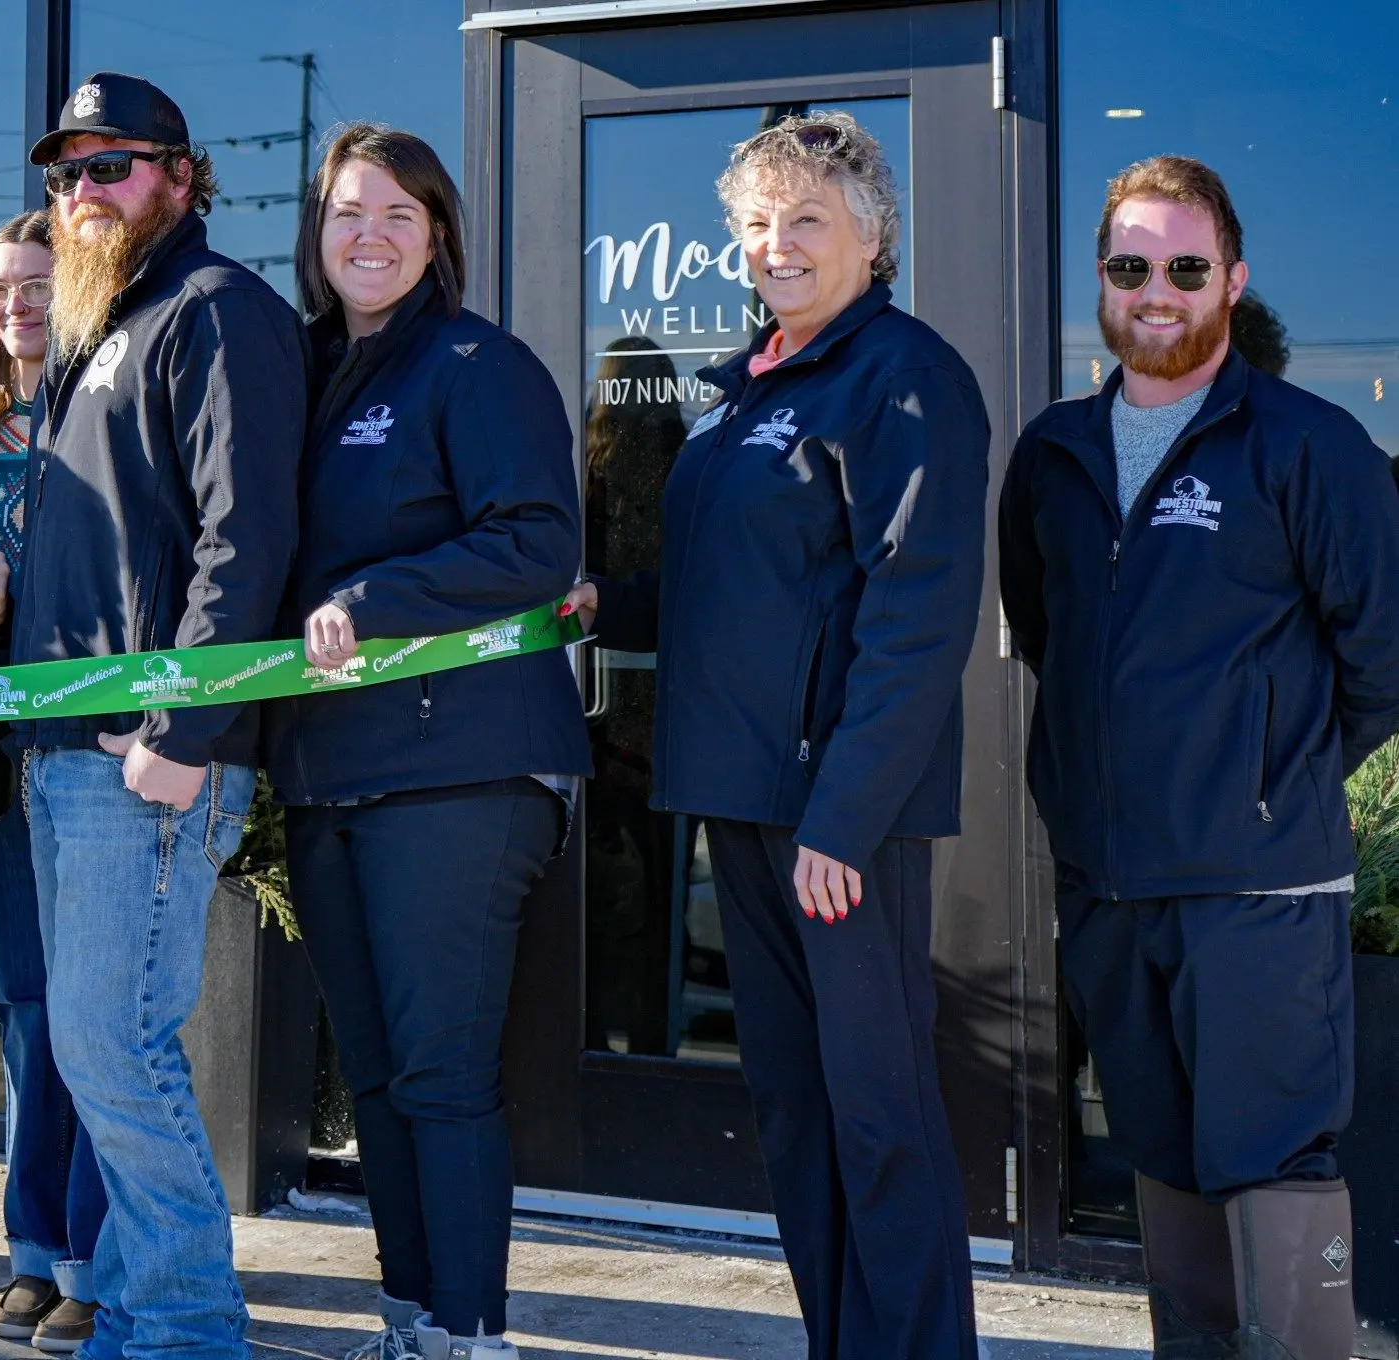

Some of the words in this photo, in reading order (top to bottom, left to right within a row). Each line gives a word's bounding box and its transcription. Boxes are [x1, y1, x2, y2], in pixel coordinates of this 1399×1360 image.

[598, 378, 631, 406] 1107
[637, 377, 651, 404] N
[655, 377, 716, 404] UNIVE
[1156, 497, 1222, 514] JAMESTOWN
[1172, 509, 1199, 517] AREA
[466, 624, 527, 647] JAMESTOWN
[488, 639, 513, 651] AREA
[204, 650, 296, 695] Congratulations
[322, 671, 349, 684] AREA
[32, 664, 123, 708] Congratulations
[130, 676, 198, 694] JAMESTOWN
